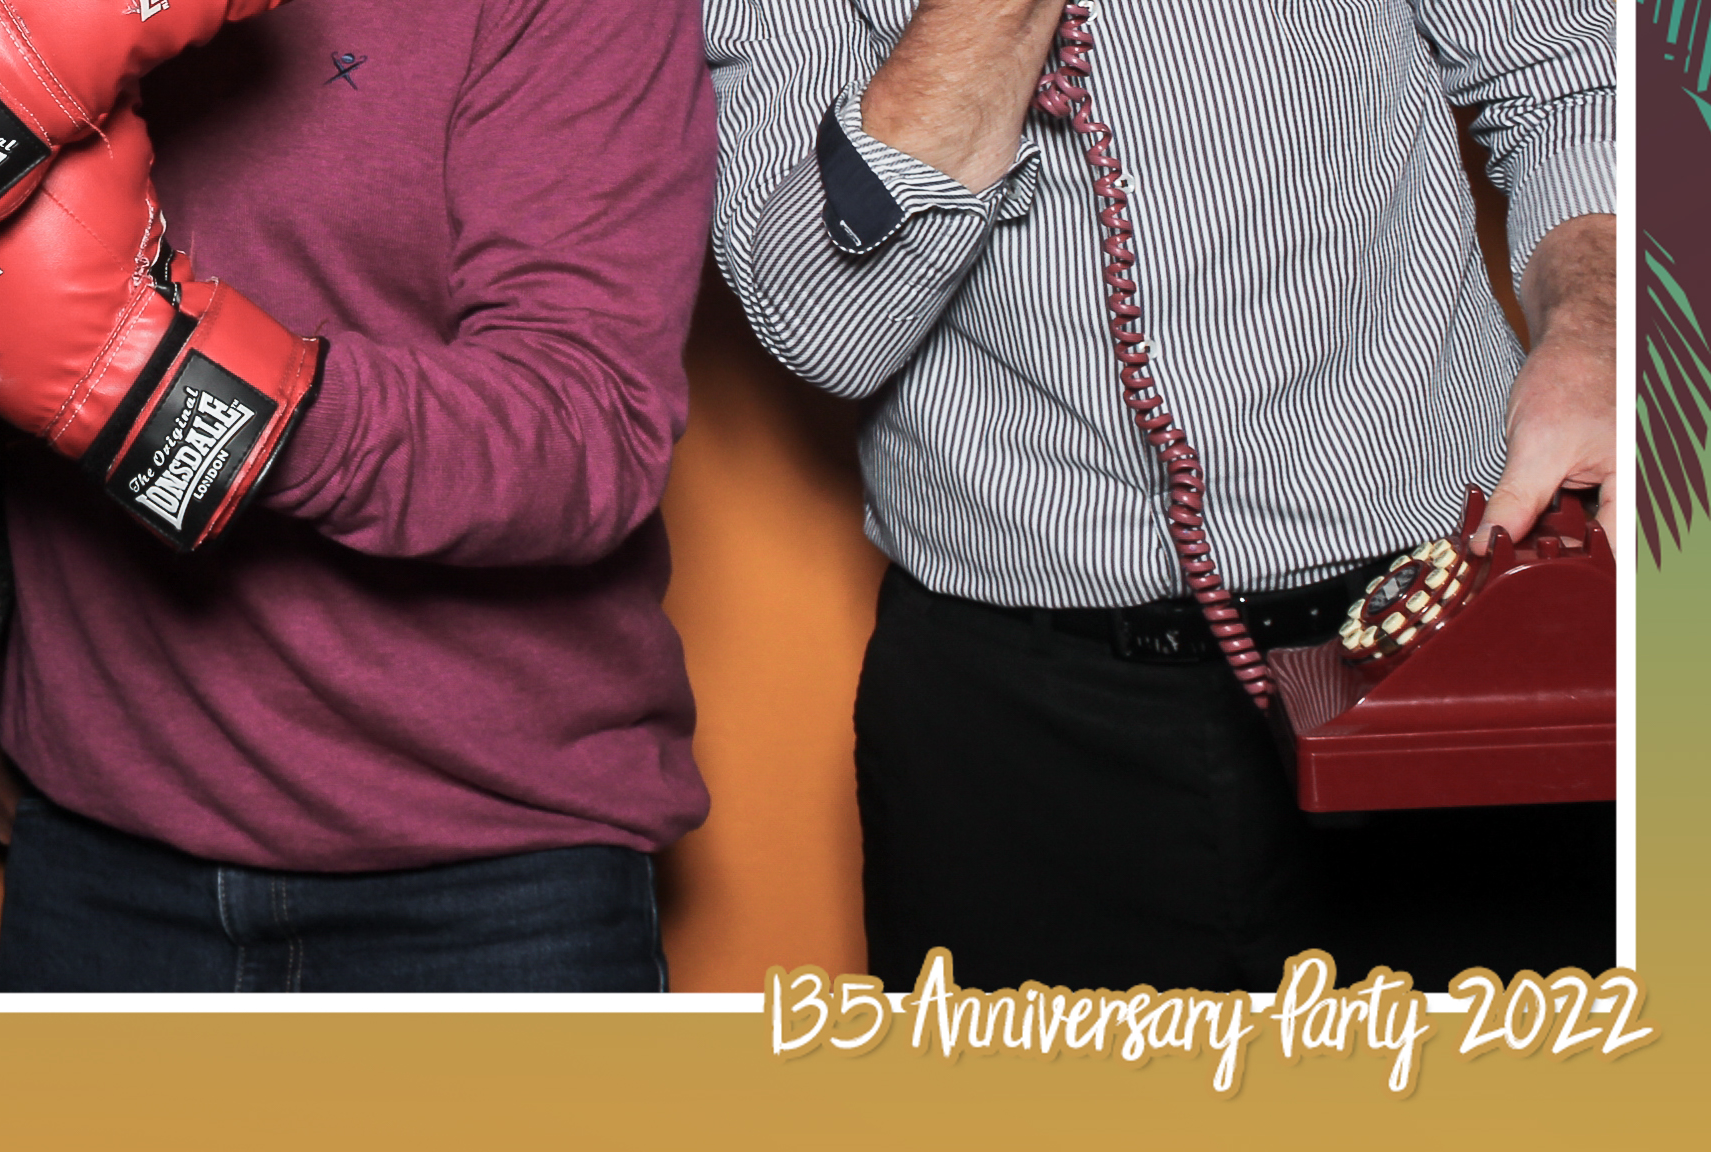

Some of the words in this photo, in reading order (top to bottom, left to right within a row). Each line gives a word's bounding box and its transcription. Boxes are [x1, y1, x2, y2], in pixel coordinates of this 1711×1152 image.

[128, 466, 155, 493] The
[152, 386, 199, 466] Original
[135, 390, 256, 531] LONSDALE
[193, 448, 230, 500] LONDON
